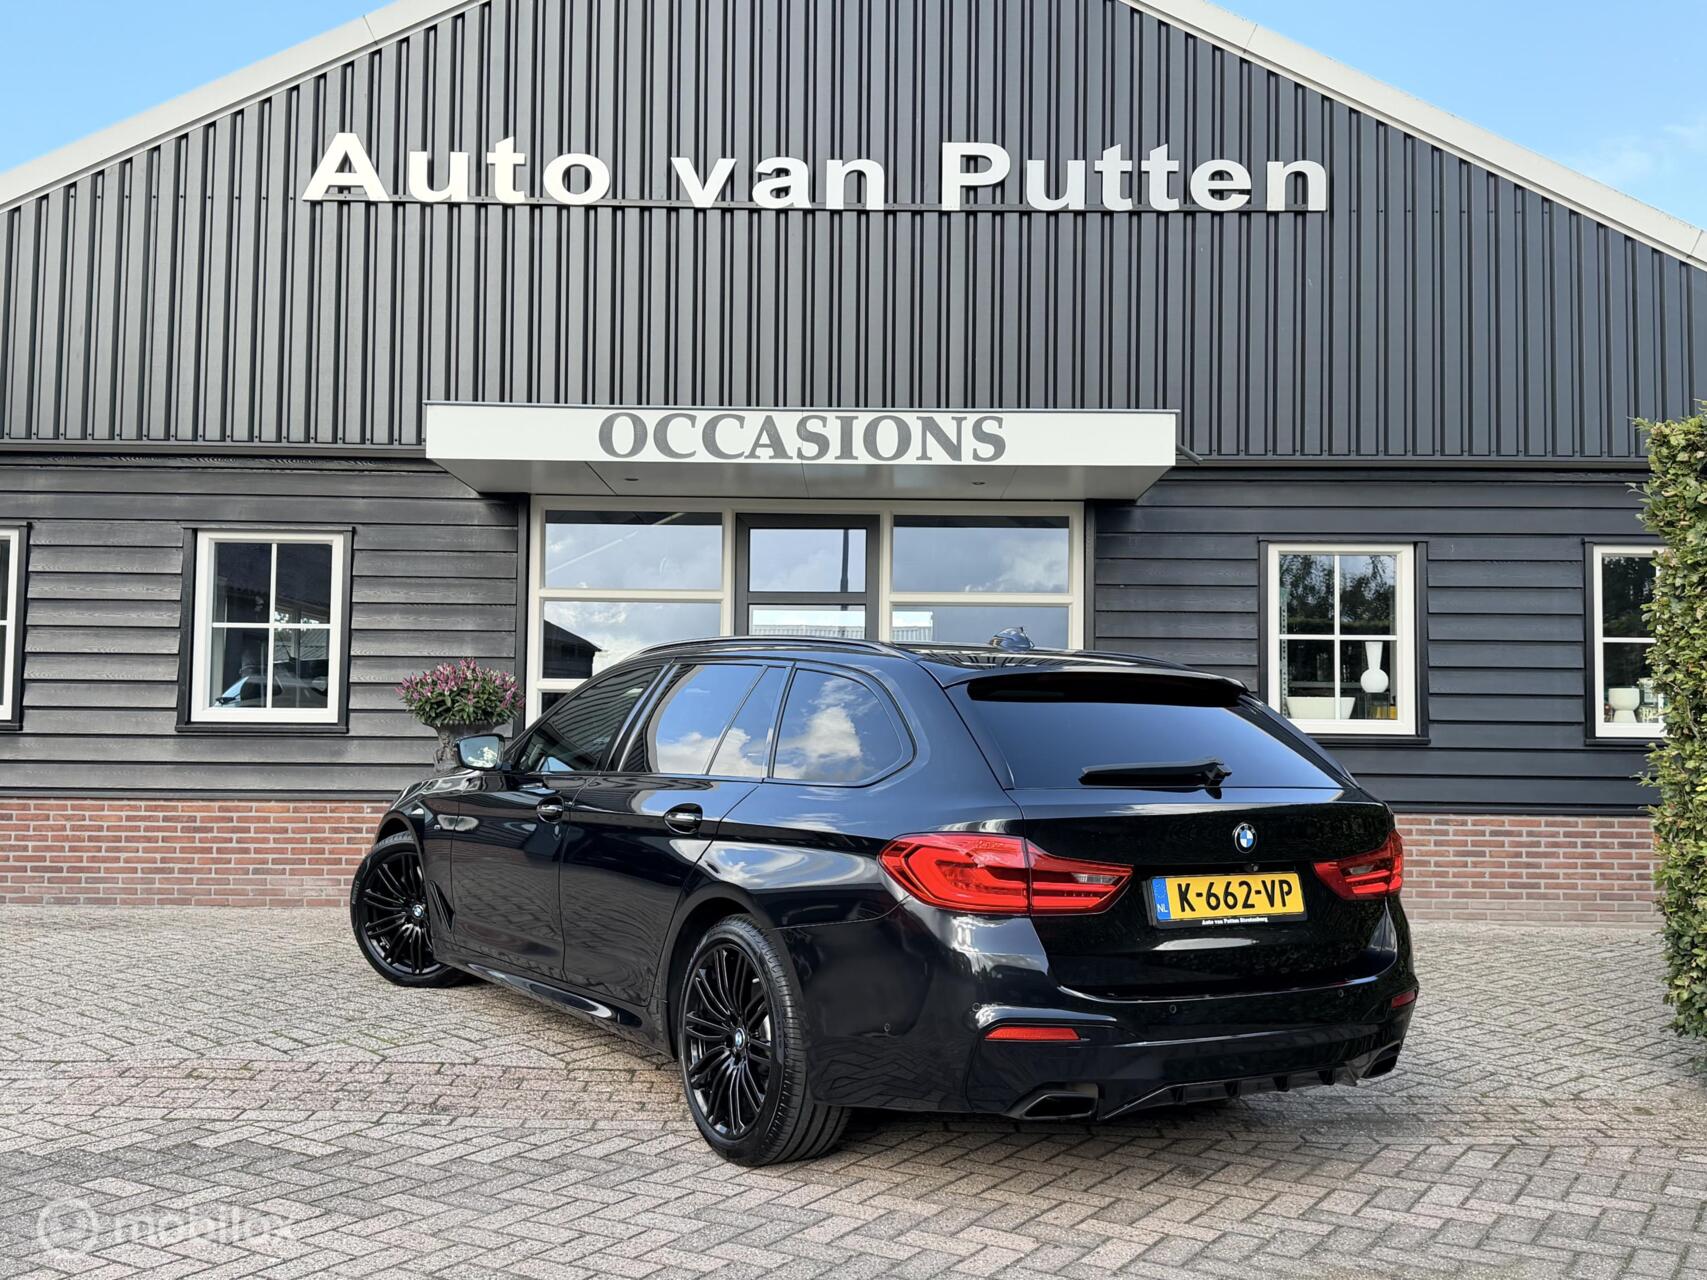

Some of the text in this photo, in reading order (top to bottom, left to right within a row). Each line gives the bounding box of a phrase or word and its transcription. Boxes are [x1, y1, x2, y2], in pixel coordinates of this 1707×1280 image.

[302, 132, 1328, 212] Auto van Putten
[599, 412, 1007, 463] OCCASIONS
[1157, 903, 1169, 913] NL
[1177, 879, 1293, 912] K-662-VP
